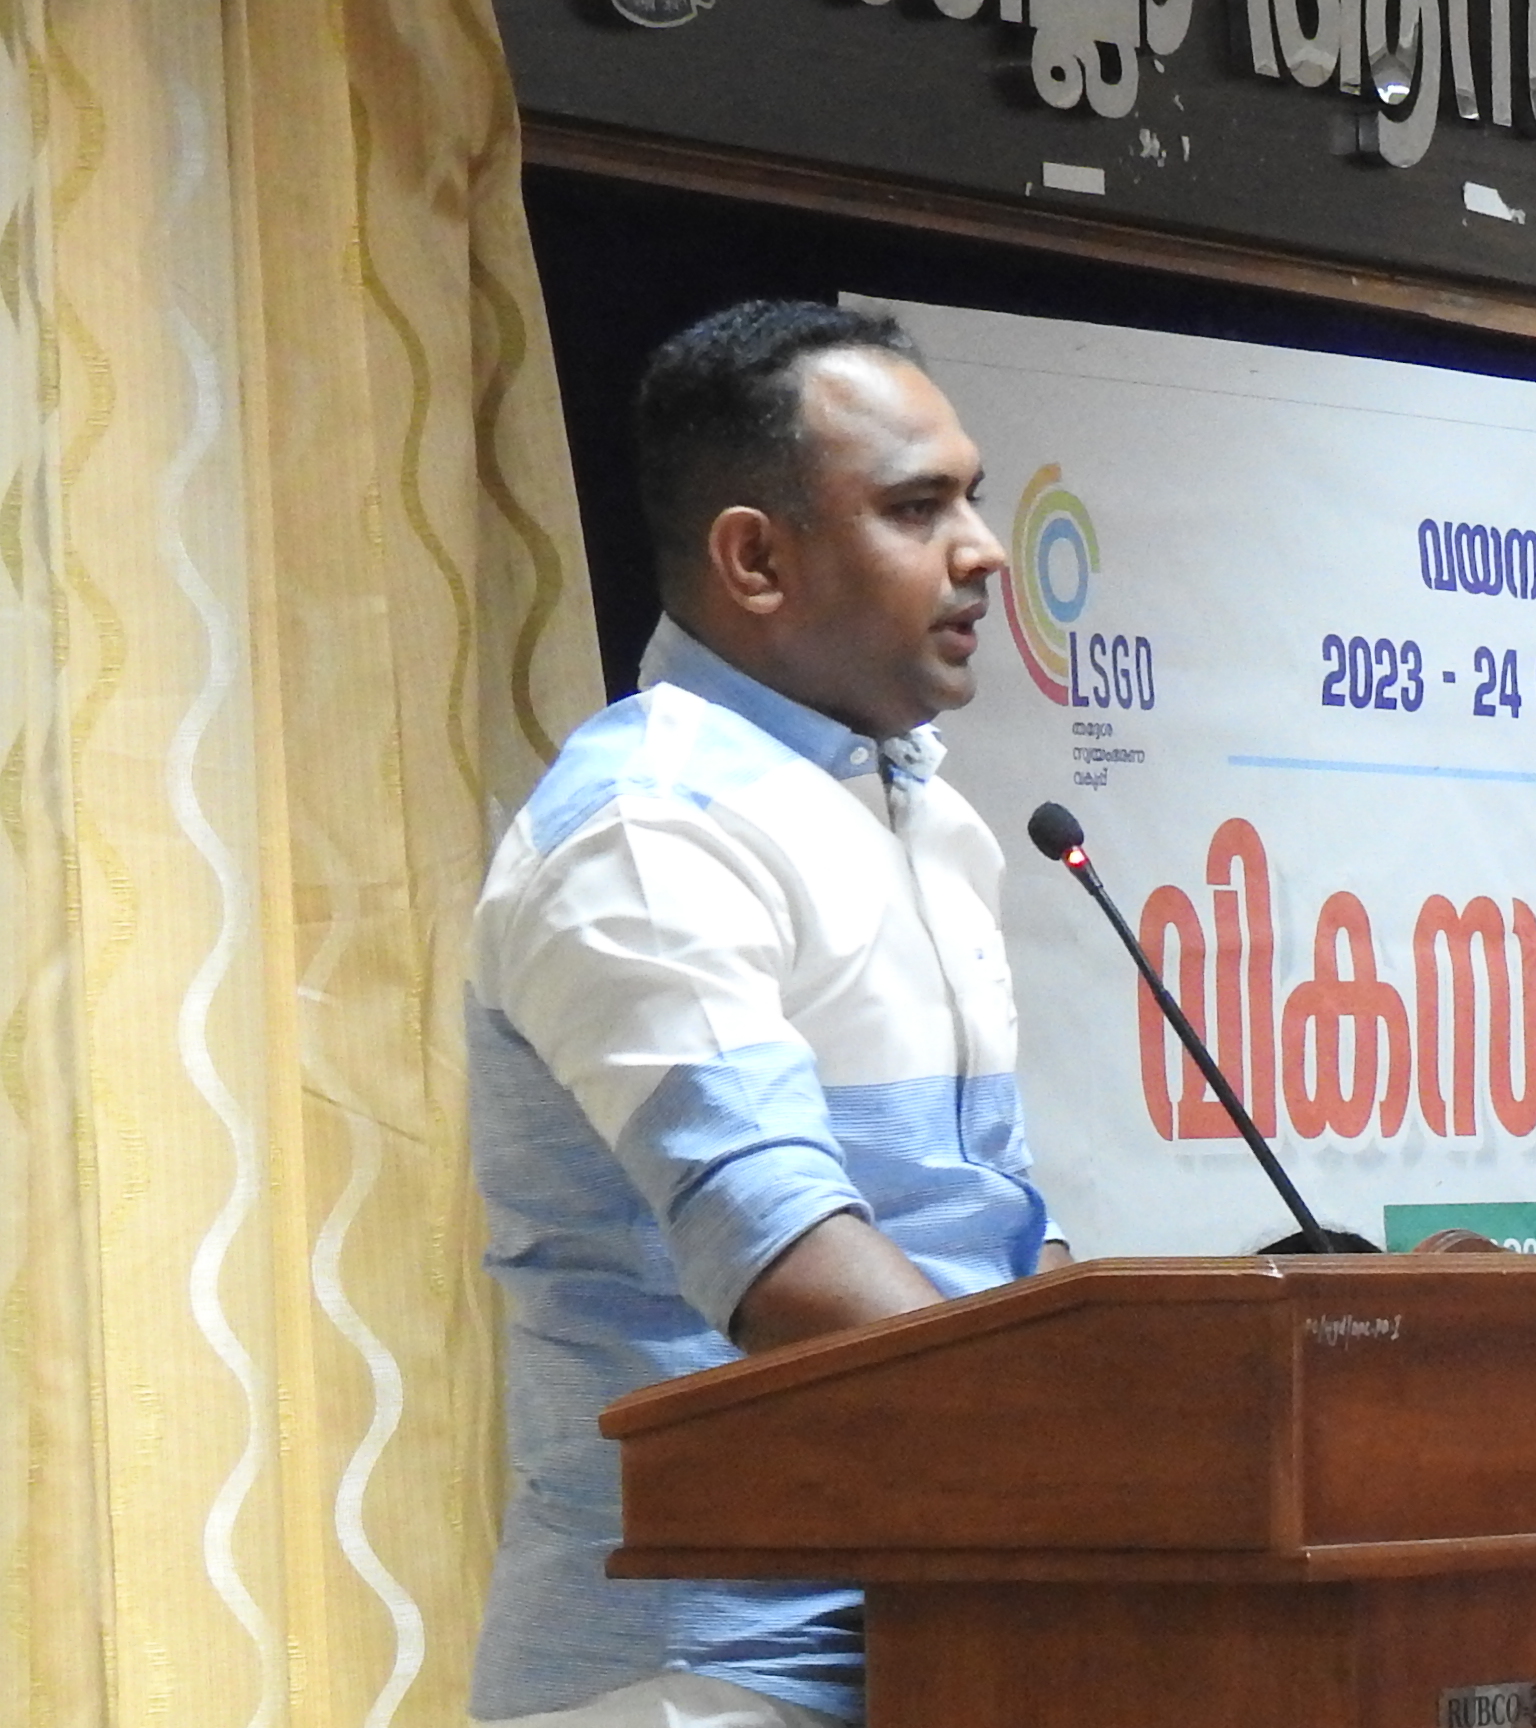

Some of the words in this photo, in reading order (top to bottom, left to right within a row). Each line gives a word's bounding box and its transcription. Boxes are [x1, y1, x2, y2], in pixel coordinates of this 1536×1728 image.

[1069, 631, 1156, 711] LSGD
[1321, 634, 1425, 713] 2023
[1473, 646, 1522, 719] 24
[1448, 1693, 1521, 1728] RUBCO
